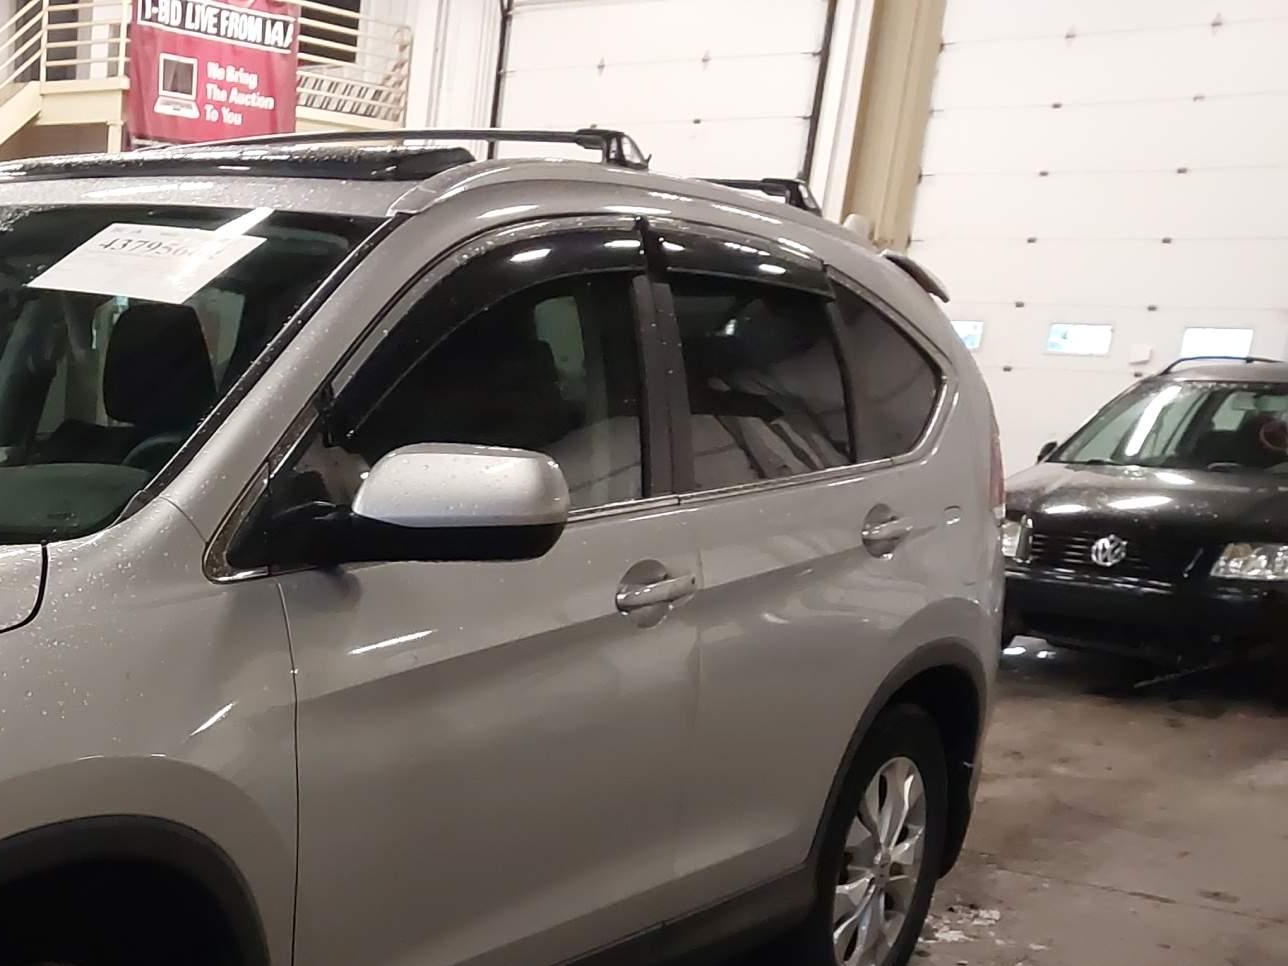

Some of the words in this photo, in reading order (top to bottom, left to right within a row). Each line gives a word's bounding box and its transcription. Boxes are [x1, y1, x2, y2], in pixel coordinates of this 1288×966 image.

[185, 3, 218, 33] LIVE
[220, 10, 262, 43] FROM
[207, 61, 225, 80] We
[226, 65, 258, 90] Bring
[206, 83, 227, 102] The
[229, 87, 274, 110] Auction
[204, 104, 219, 122] To
[221, 106, 242, 125] You
